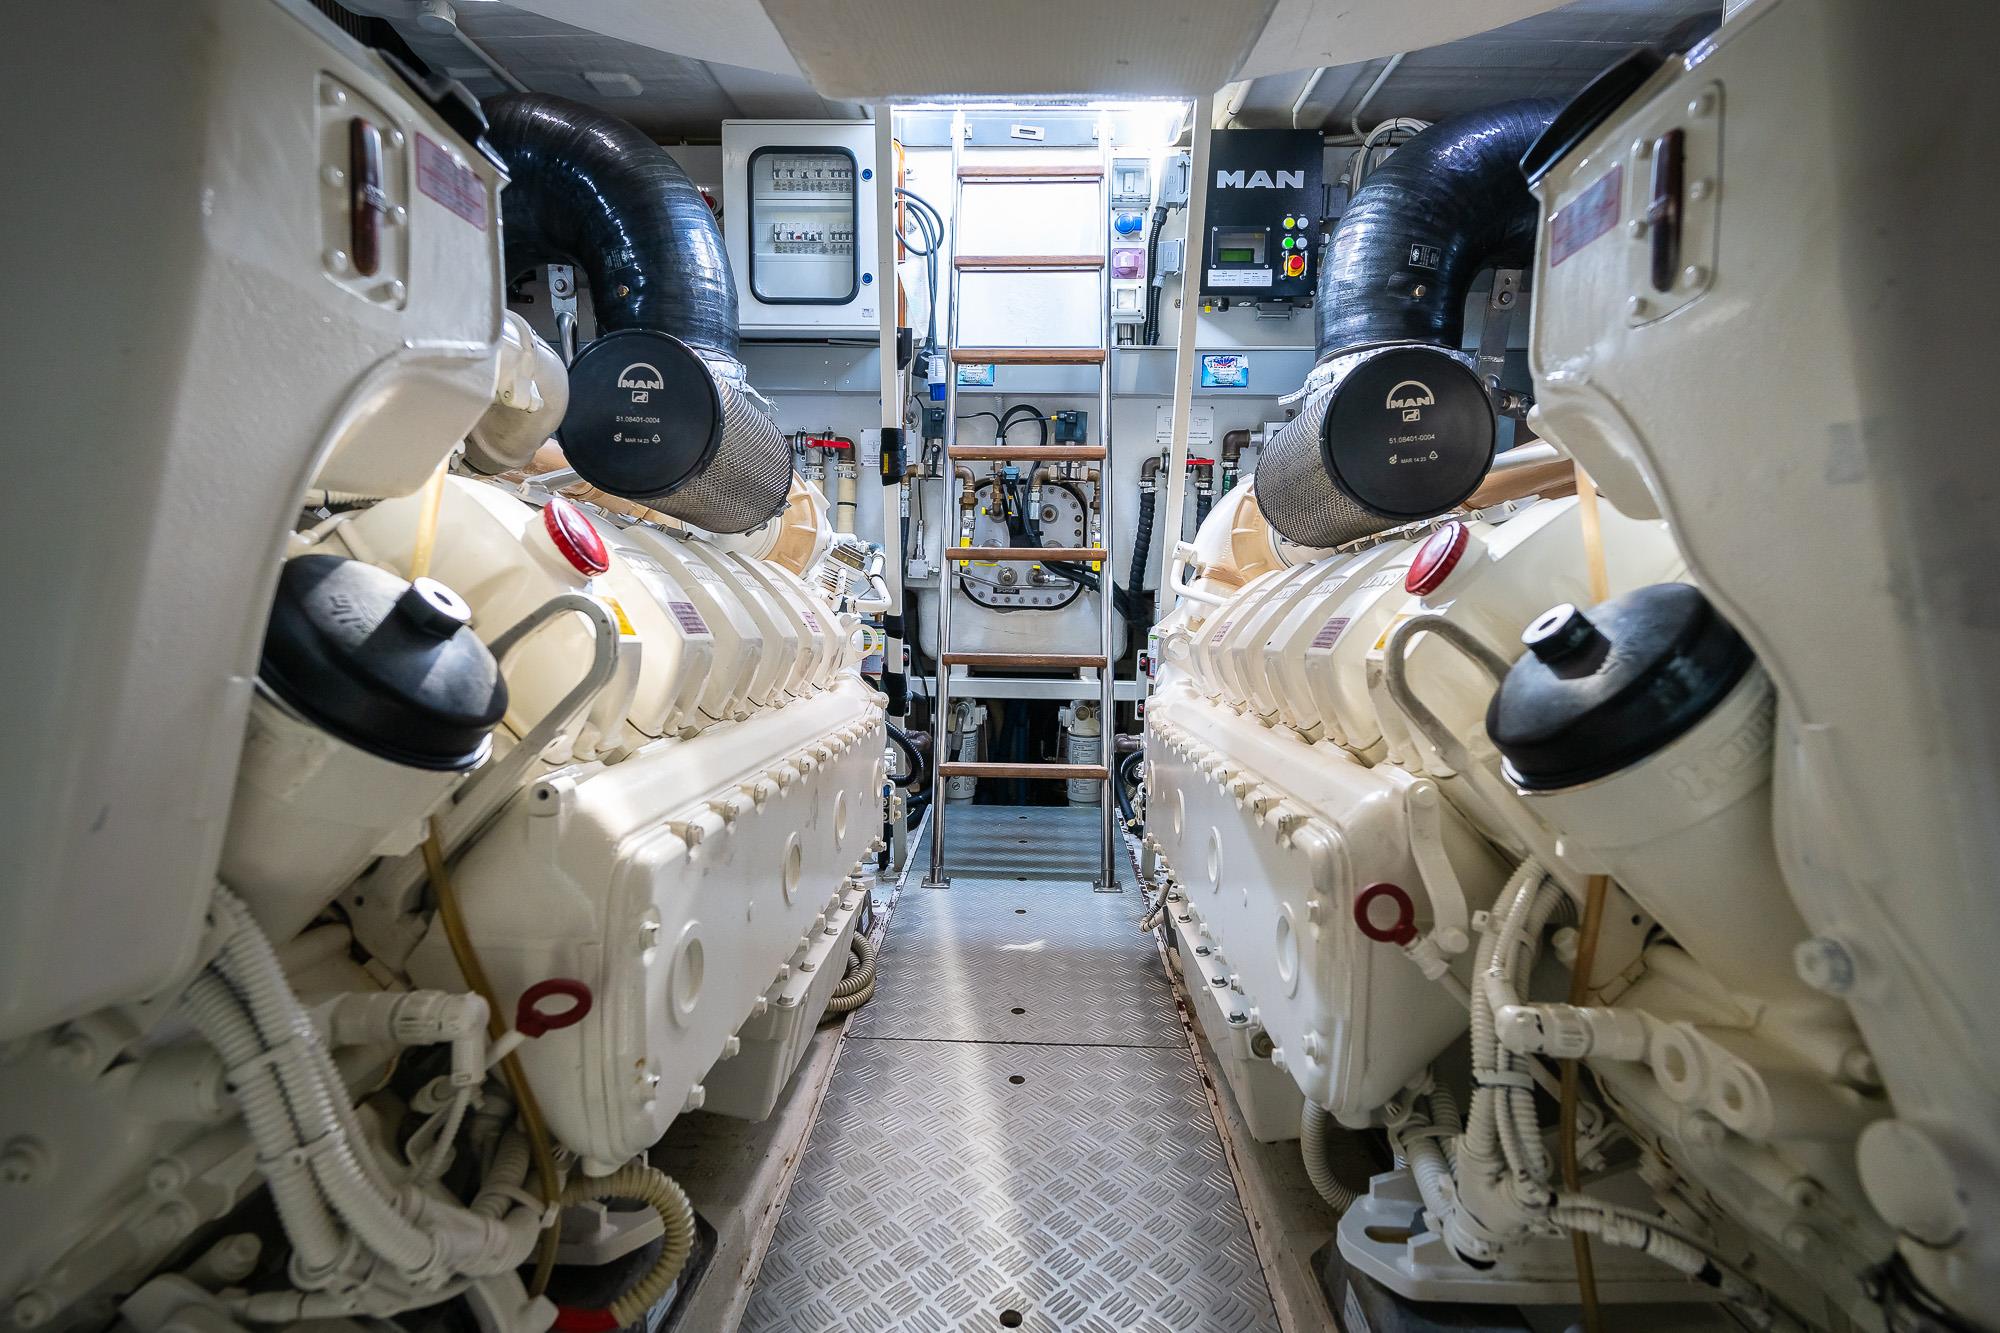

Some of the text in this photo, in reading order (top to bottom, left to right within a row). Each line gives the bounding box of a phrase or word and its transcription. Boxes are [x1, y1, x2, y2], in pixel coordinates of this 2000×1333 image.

[1216, 170, 1305, 189] MAN
[622, 379, 660, 389] MAN
[1391, 397, 1430, 408] MAN
